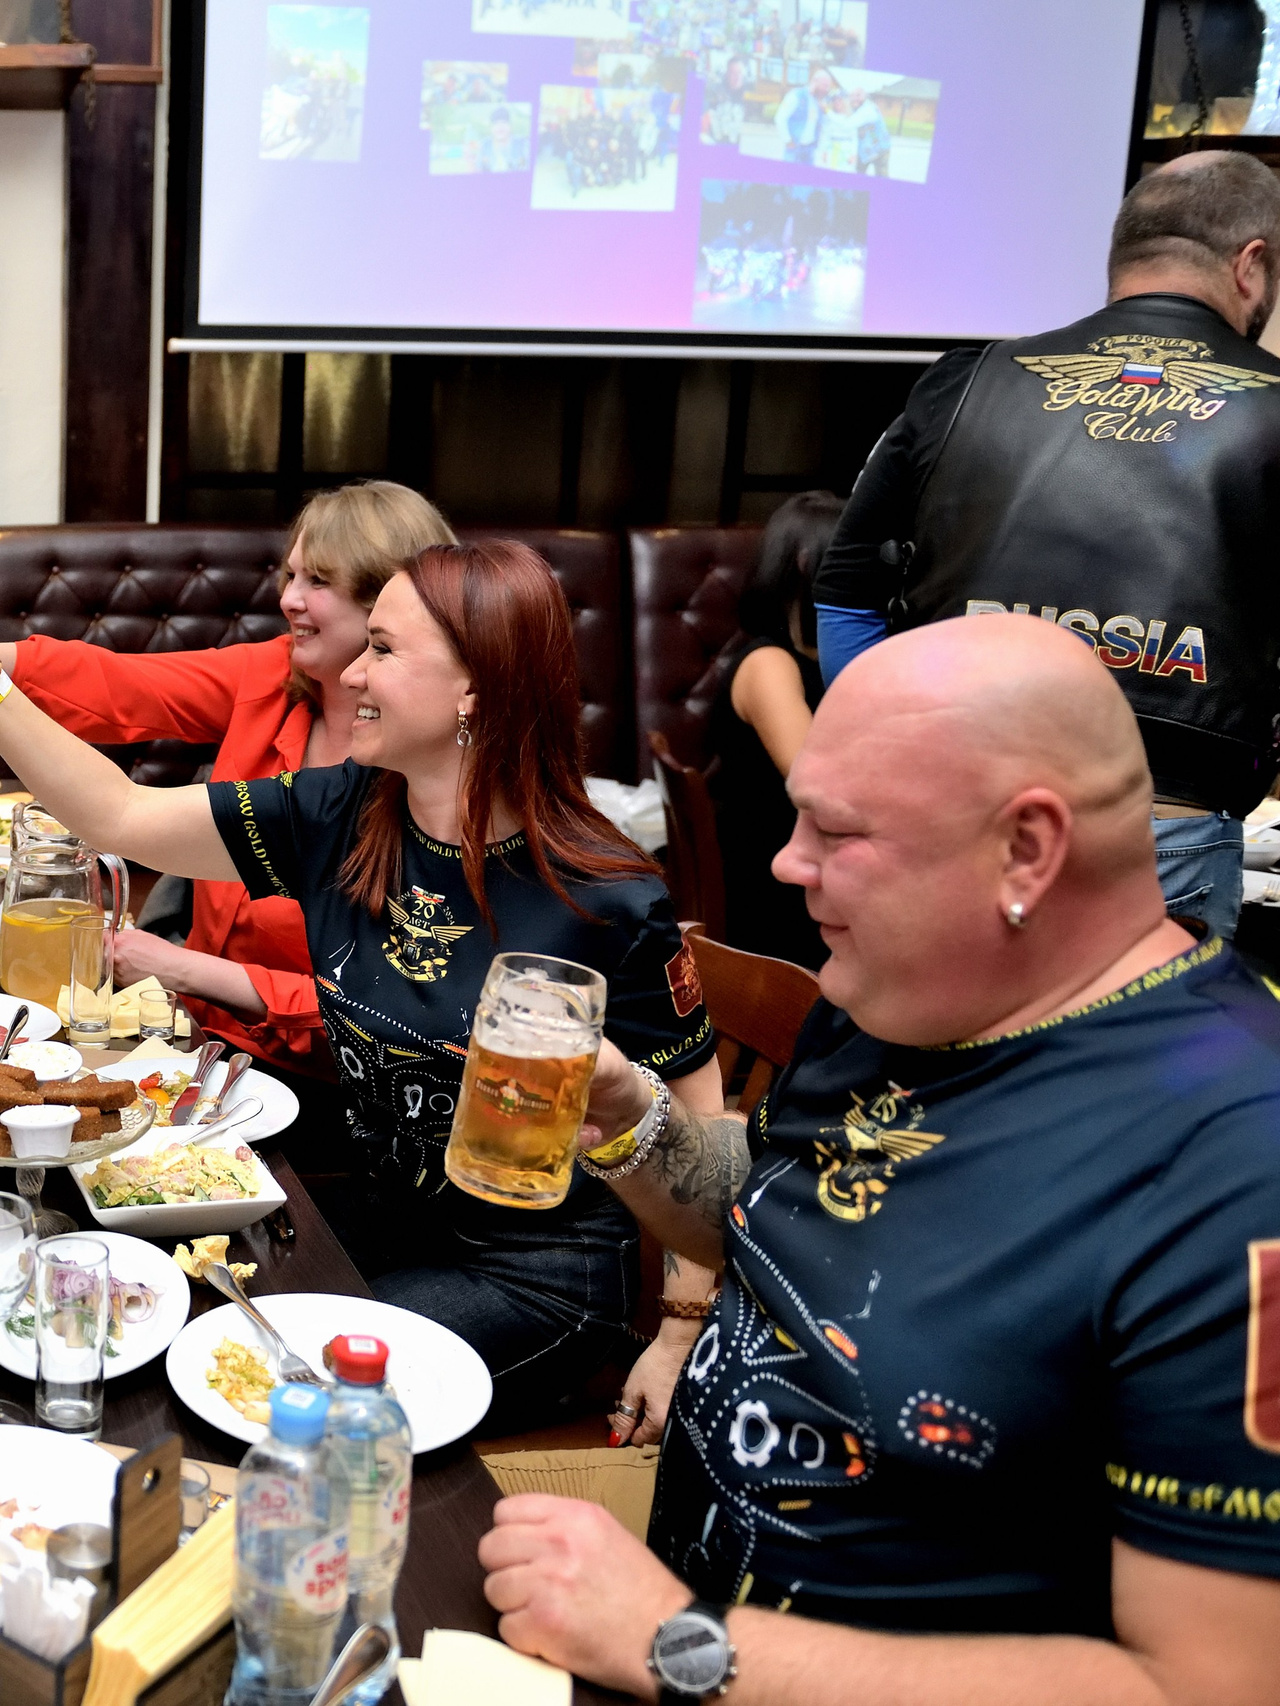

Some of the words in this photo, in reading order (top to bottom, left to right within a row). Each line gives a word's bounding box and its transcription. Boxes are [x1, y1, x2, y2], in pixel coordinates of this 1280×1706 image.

[1084, 411, 1177, 442] Club
[244, 820, 267, 859] GOLD
[411, 900, 435, 919] 20
